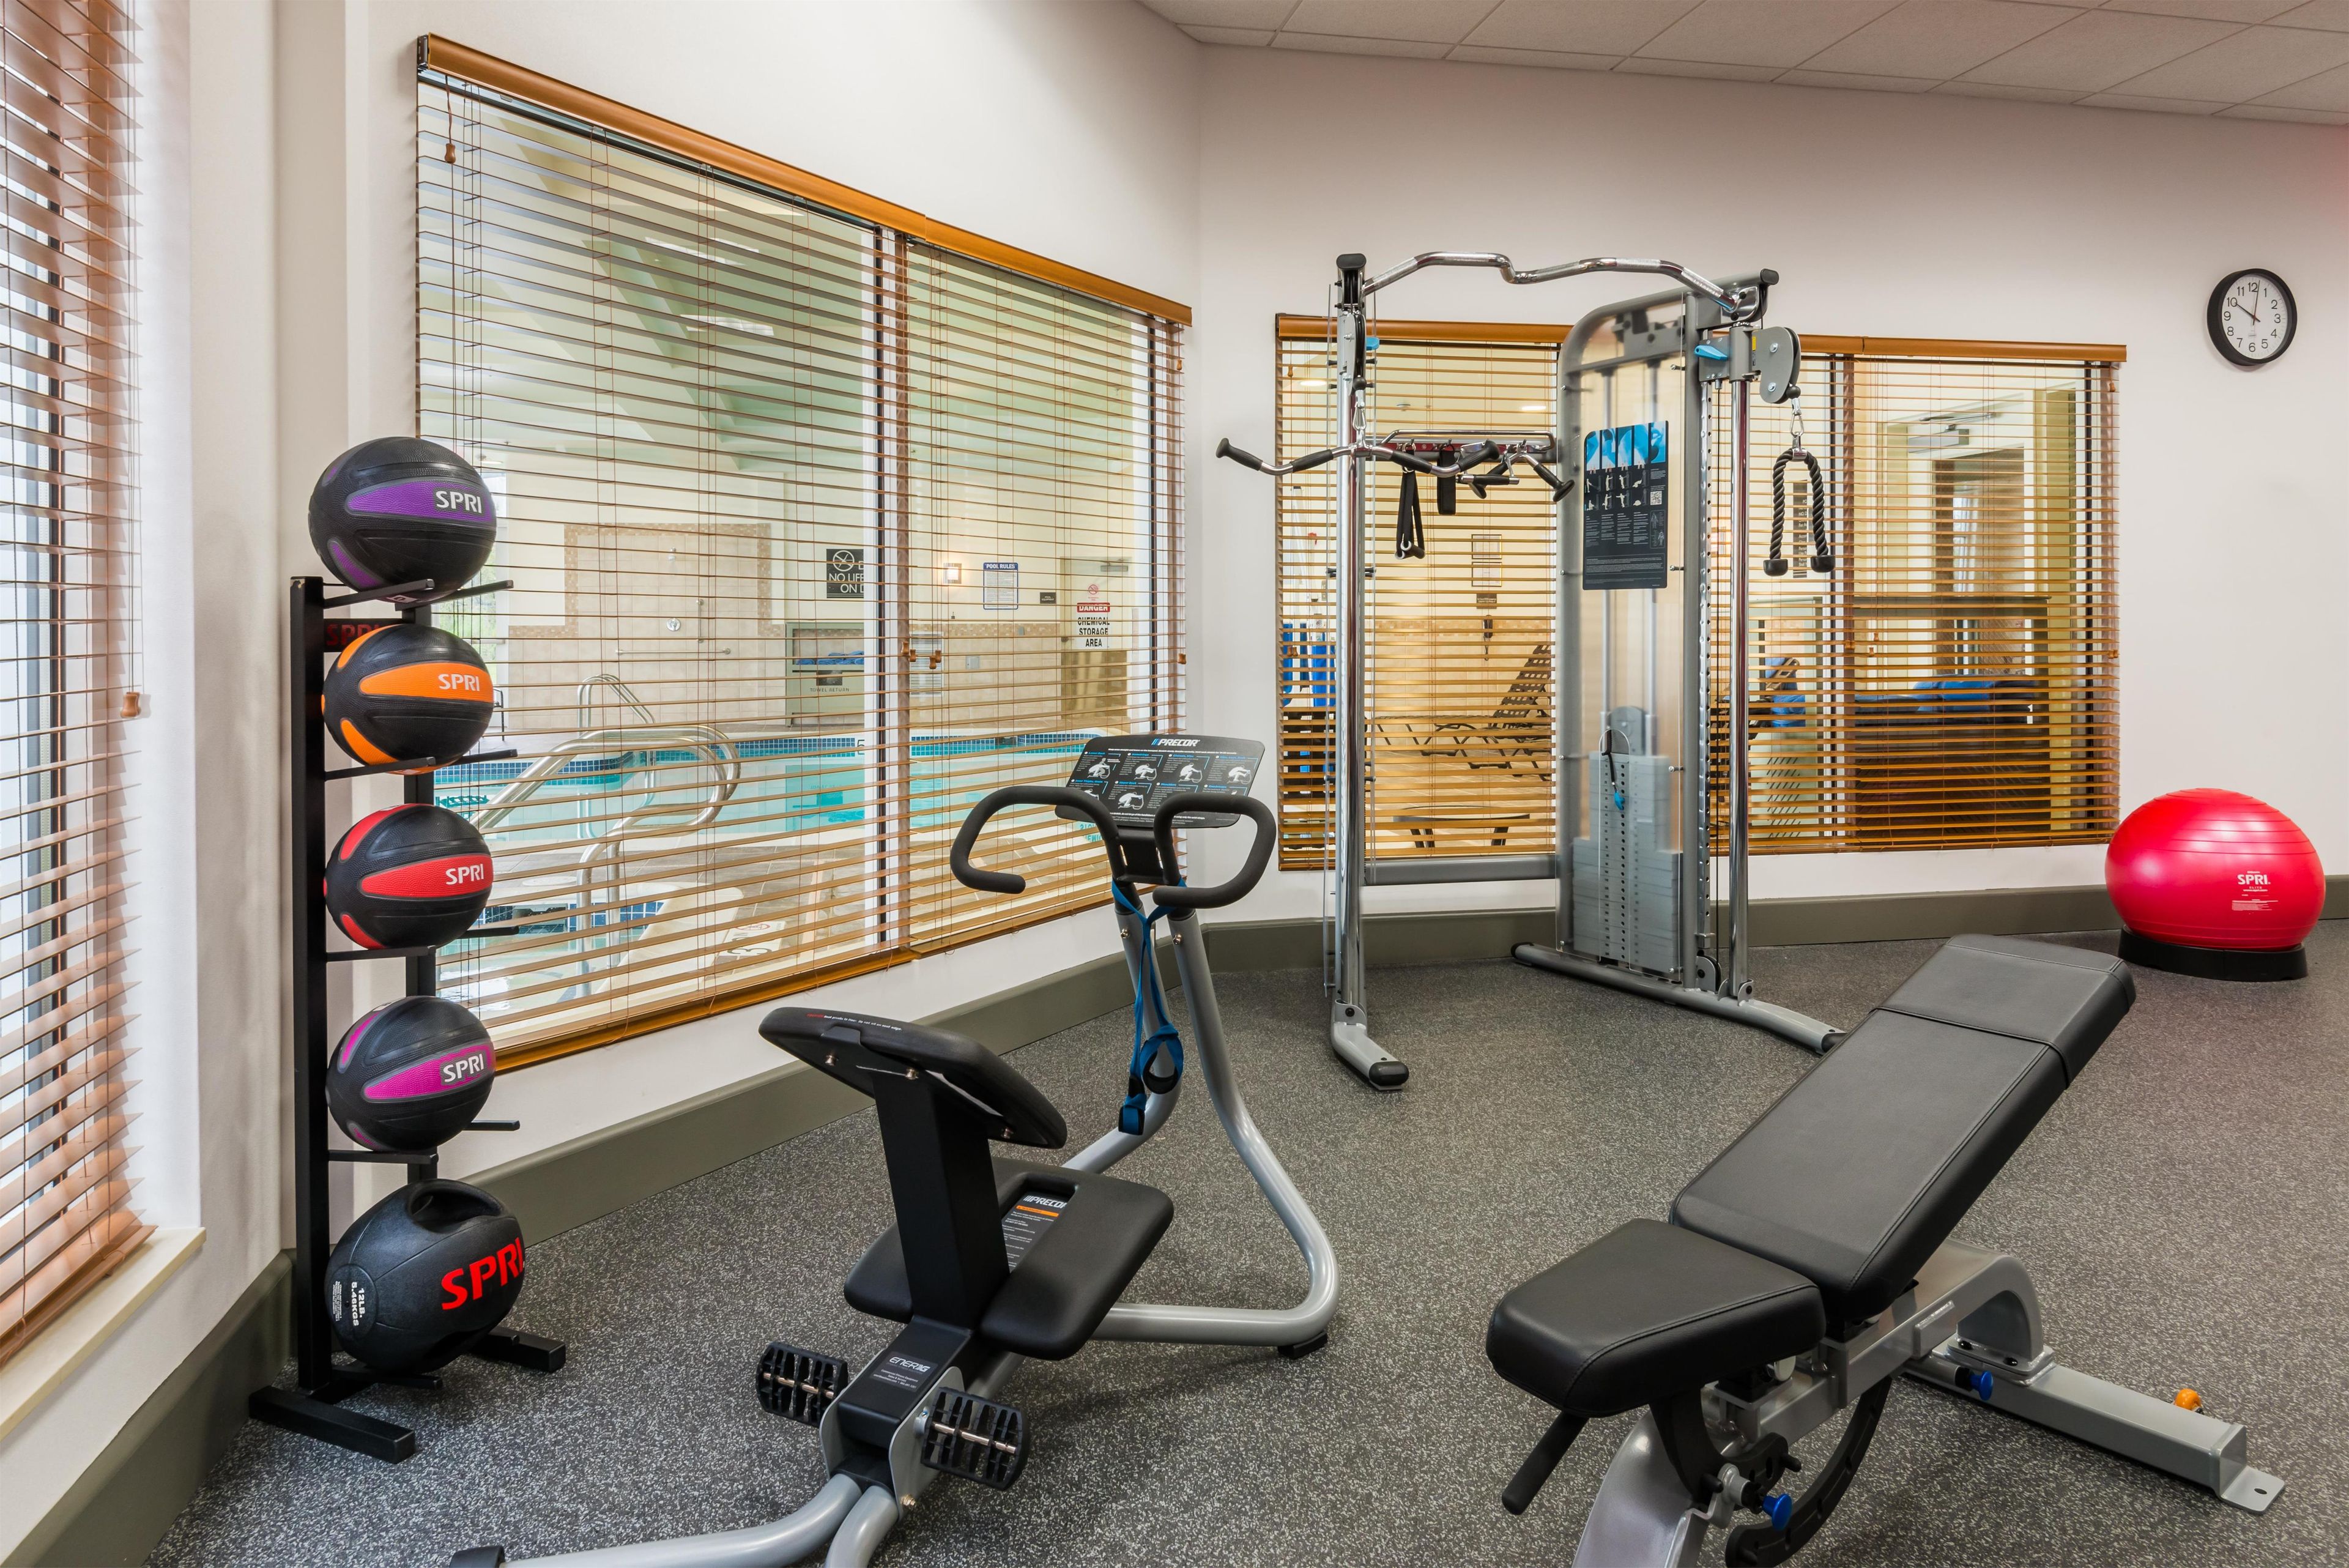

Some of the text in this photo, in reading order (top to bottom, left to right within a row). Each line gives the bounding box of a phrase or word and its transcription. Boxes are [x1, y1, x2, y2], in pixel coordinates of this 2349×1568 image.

[2237, 286, 2244, 296] 11
[2247, 282, 2258, 292] 12
[2264, 288, 2267, 297] 1
[2227, 297, 2238, 307] 10
[2271, 300, 2277, 309] 2
[2224, 311, 2231, 321] 9
[2274, 313, 2280, 323] 3
[2227, 326, 2234, 336] 8
[2271, 329, 2277, 338] 4
[2236, 338, 2243, 347] 7
[2249, 343, 2255, 352] 6
[2262, 339, 2268, 348] 5
[436, 490, 482, 514] SPRI
[829, 573, 845, 581] NO
[841, 584, 857, 593] ON
[1078, 617, 1110, 625] CHEMICAL
[1085, 638, 1102, 647] AREA
[437, 673, 480, 691] SPRI
[1158, 738, 1198, 747] PRECOR
[445, 863, 484, 885] SPRI
[2237, 874, 2268, 885] SPRI
[443, 1053, 484, 1083] SPRI
[441, 1237, 524, 1310] SPRI
